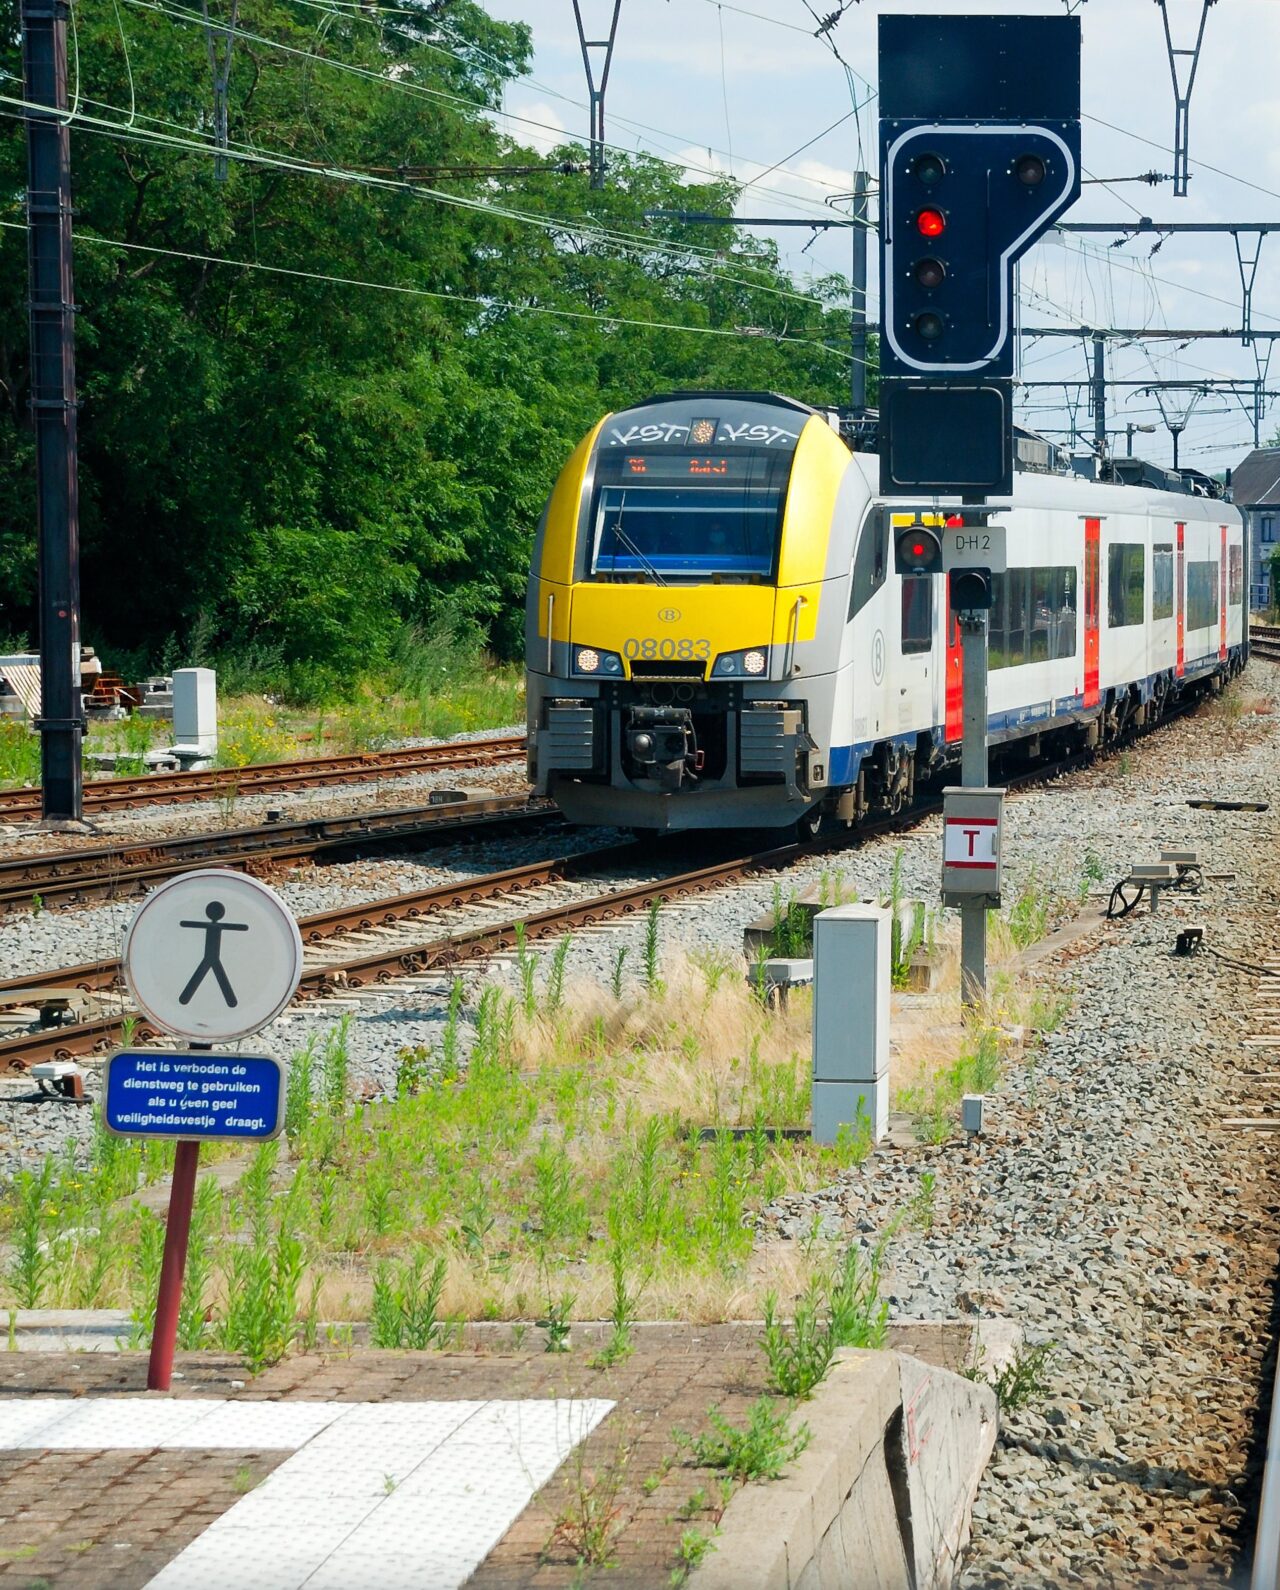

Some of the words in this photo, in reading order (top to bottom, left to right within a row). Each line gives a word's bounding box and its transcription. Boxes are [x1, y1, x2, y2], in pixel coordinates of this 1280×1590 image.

[623, 638, 711, 661] 08083
[963, 830, 980, 856] T
[136, 1061, 156, 1072] Het
[160, 1062, 170, 1072] is
[173, 1062, 229, 1075] verboden
[231, 1064, 247, 1075] de
[123, 1078, 184, 1092] dienstweg
[187, 1080, 198, 1091] te
[202, 1081, 261, 1094] gebruiken
[148, 1097, 166, 1107] als
[168, 1099, 177, 1107] u
[212, 1099, 237, 1111] geel
[116, 1112, 216, 1127] veiligheidsvestje
[225, 1116, 267, 1130] draagt.
